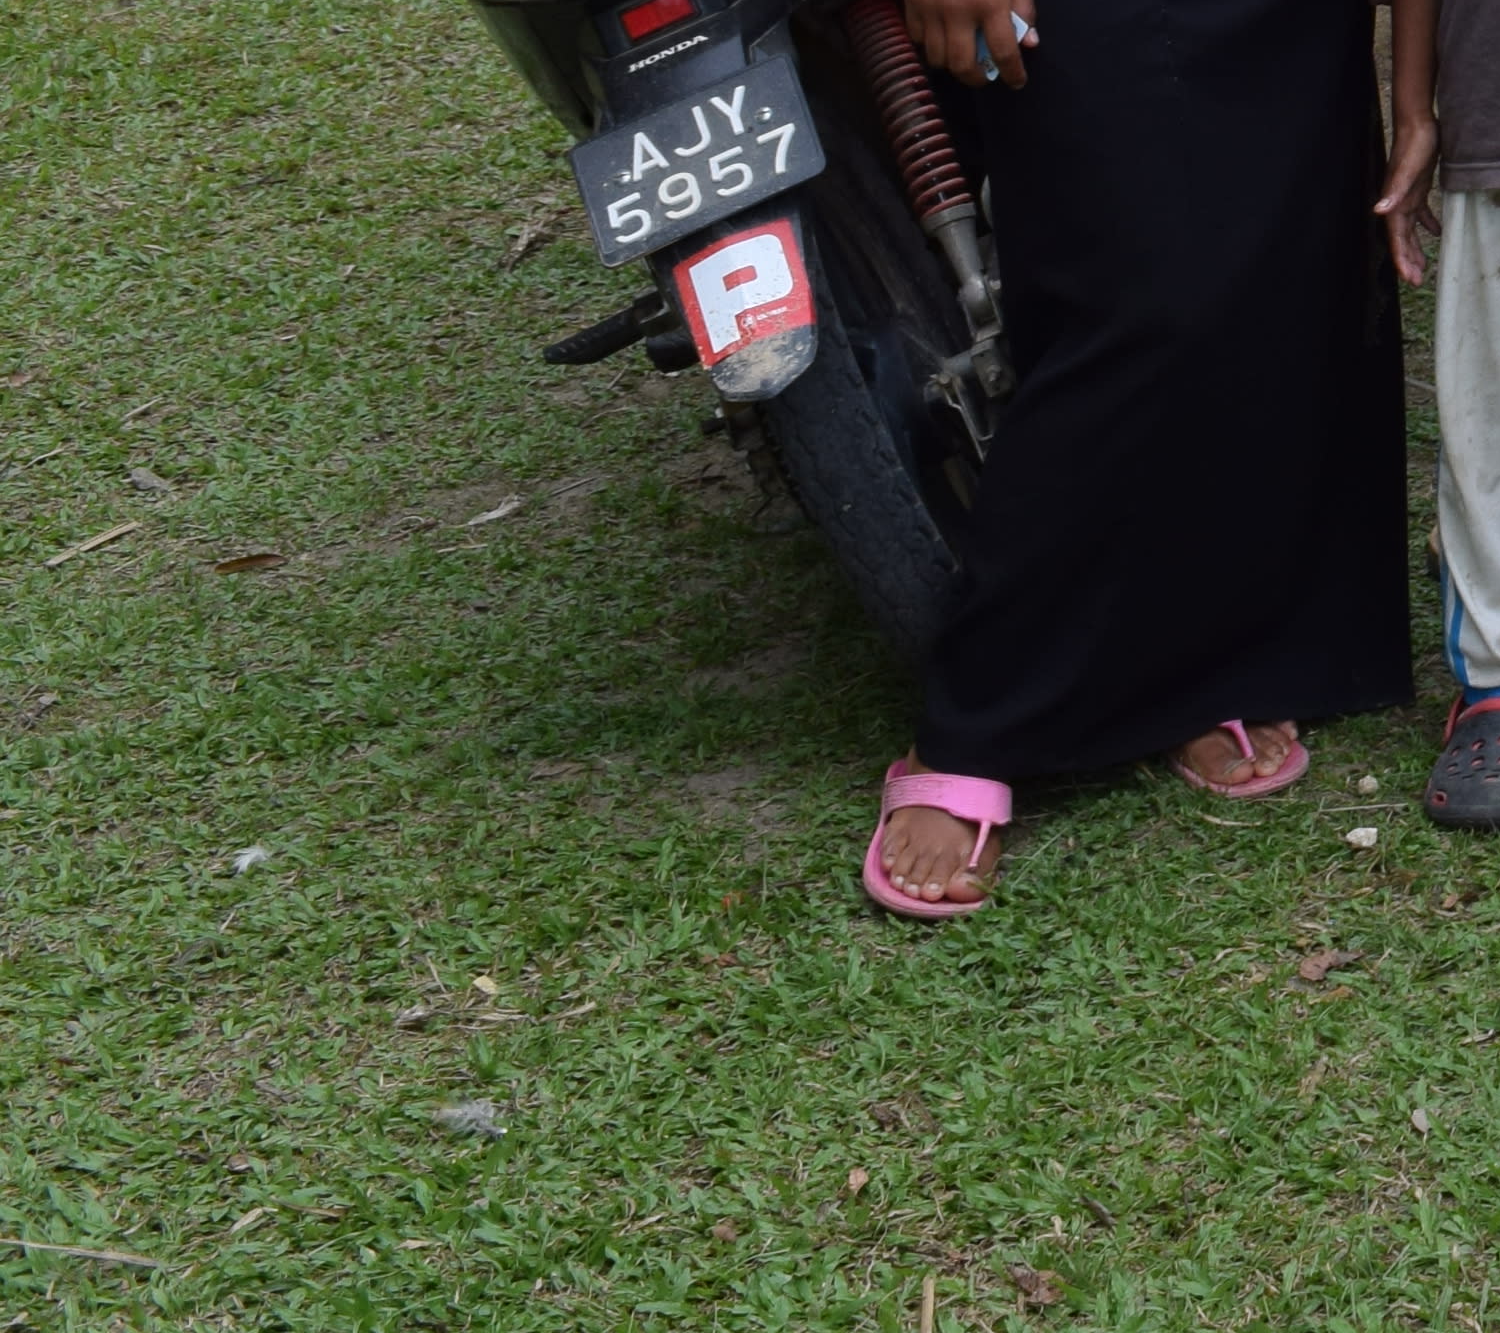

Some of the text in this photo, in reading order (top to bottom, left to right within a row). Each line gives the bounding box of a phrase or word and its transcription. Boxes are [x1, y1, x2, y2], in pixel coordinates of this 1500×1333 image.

[627, 34, 709, 74] HONDA
[606, 123, 797, 244] 5957
[632, 85, 746, 182] AJY
[688, 234, 793, 354] P
